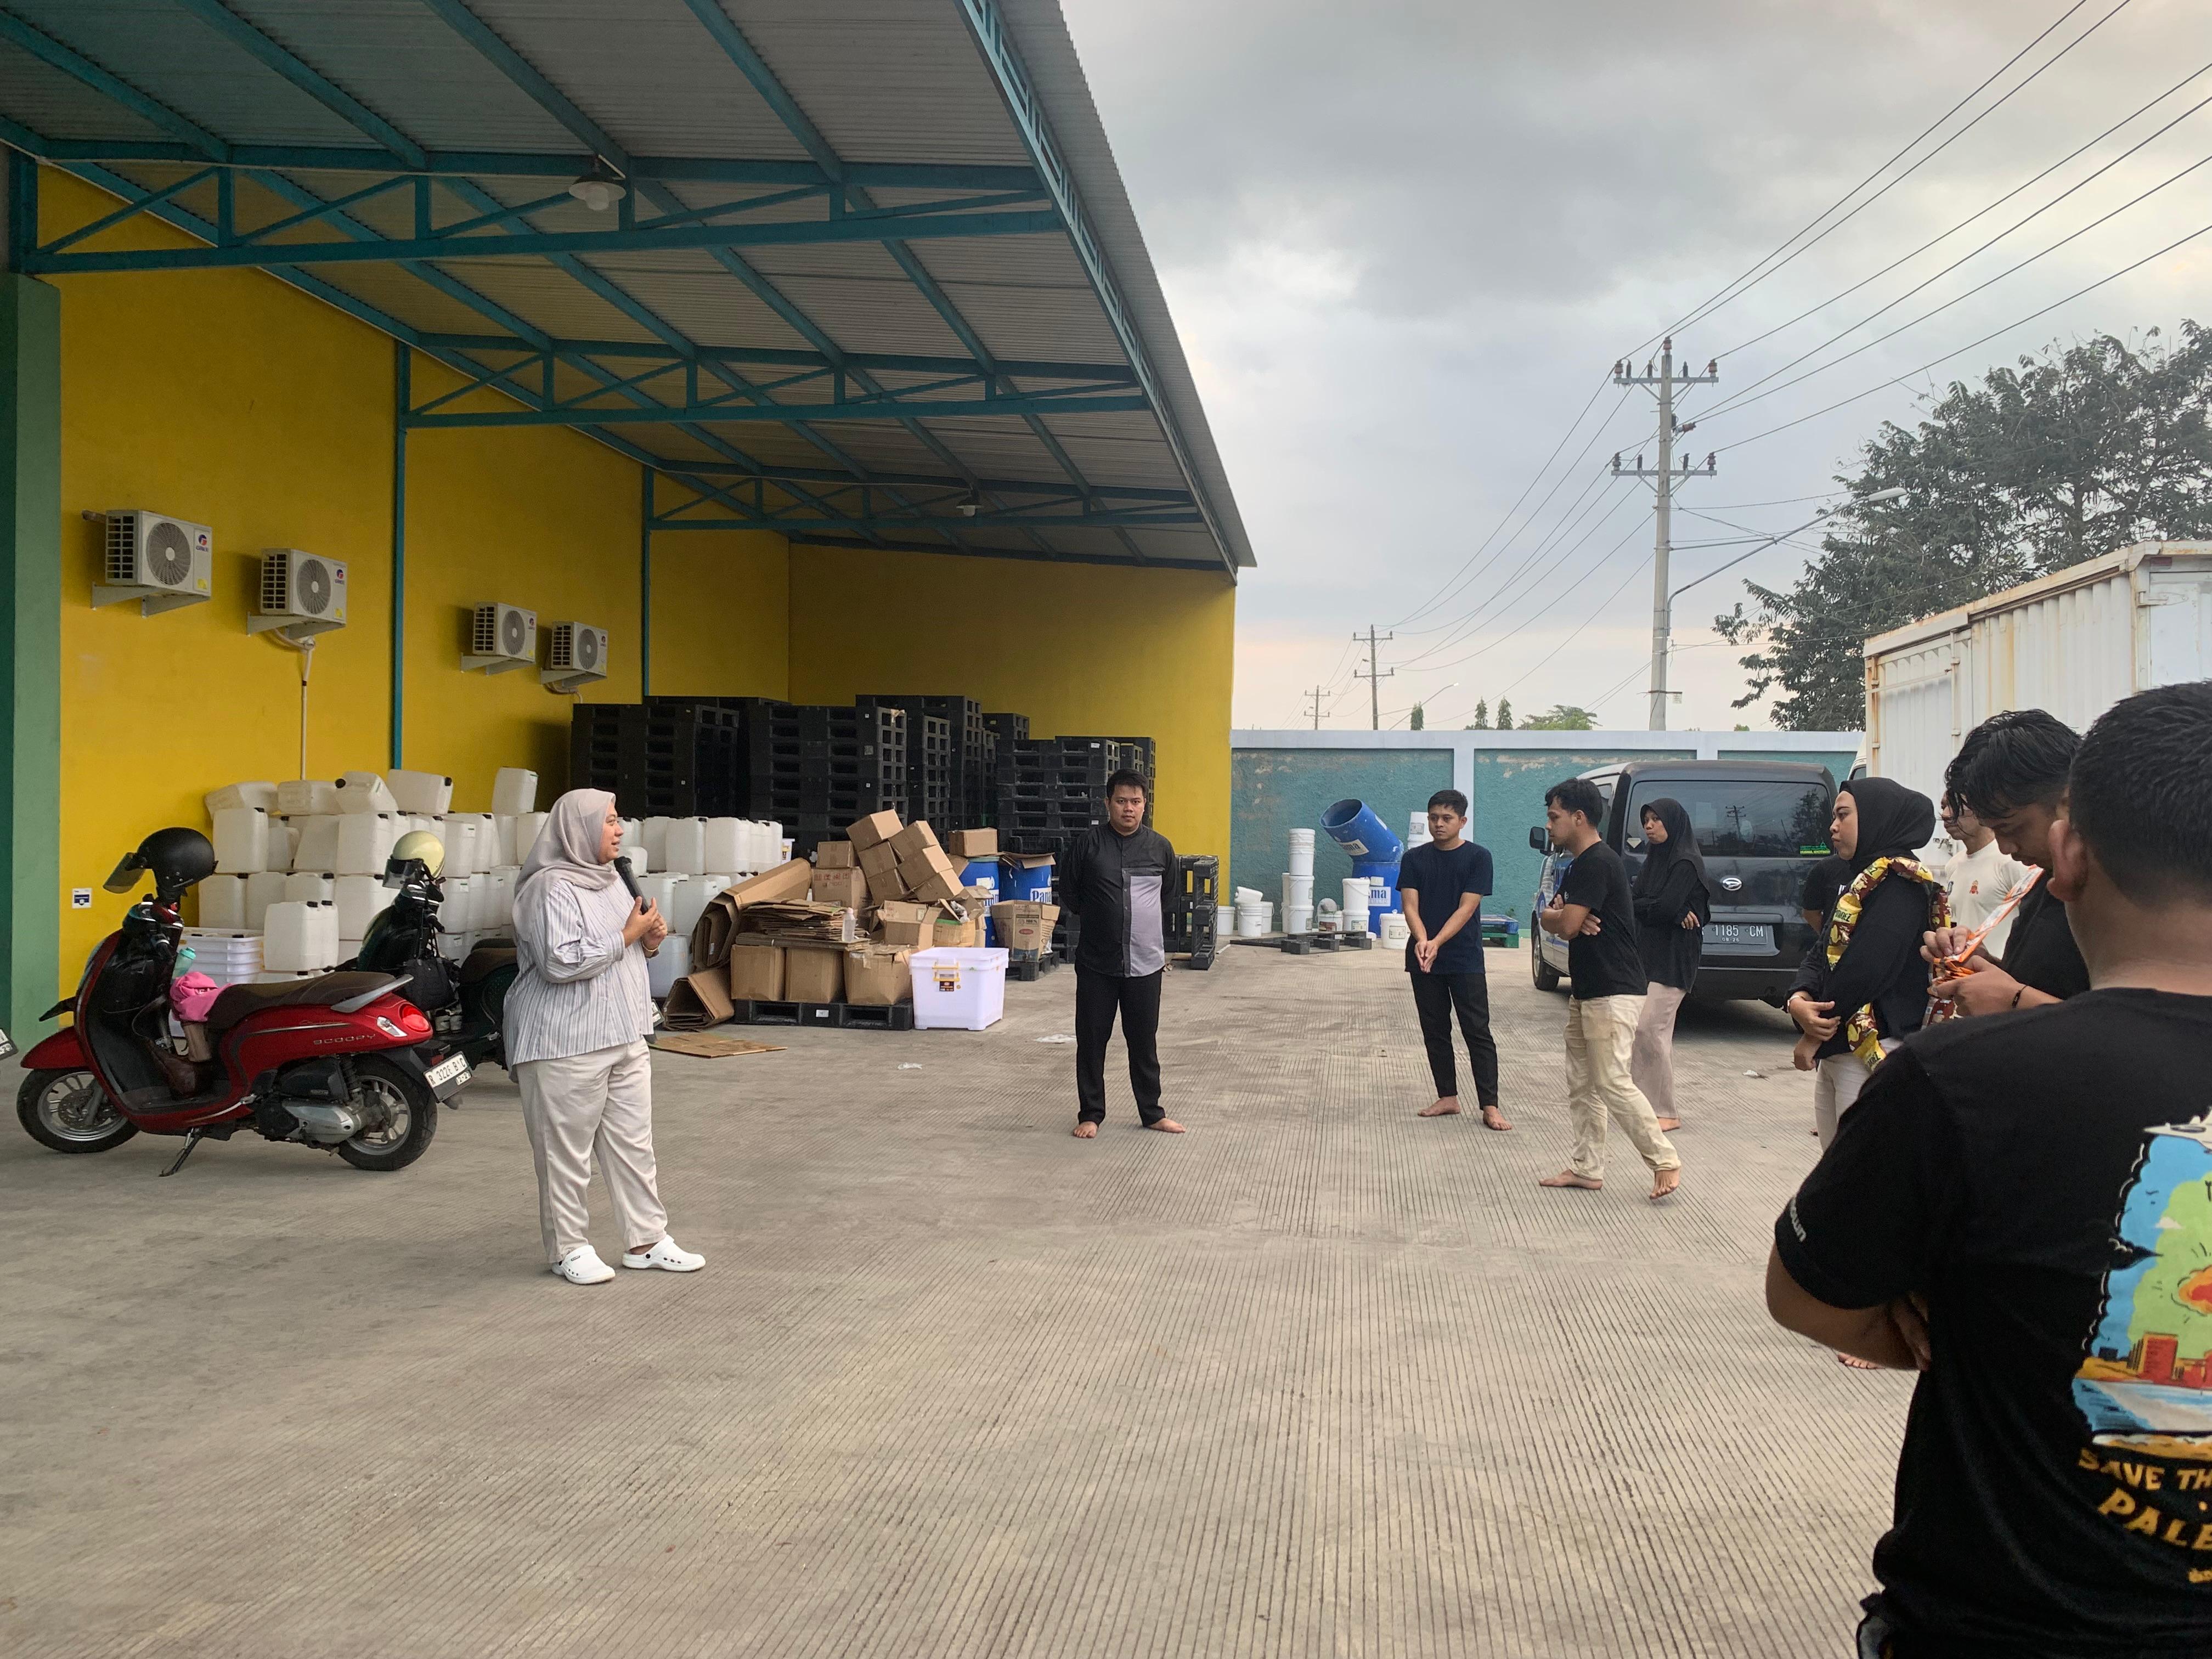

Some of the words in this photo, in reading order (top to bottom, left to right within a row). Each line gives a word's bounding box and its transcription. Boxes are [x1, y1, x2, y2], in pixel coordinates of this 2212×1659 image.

[1715, 925, 1739, 936] 1185
[1750, 925, 1764, 937] CM
[428, 1075, 436, 1085] R
[2078, 1447, 2166, 1491] SAVE
